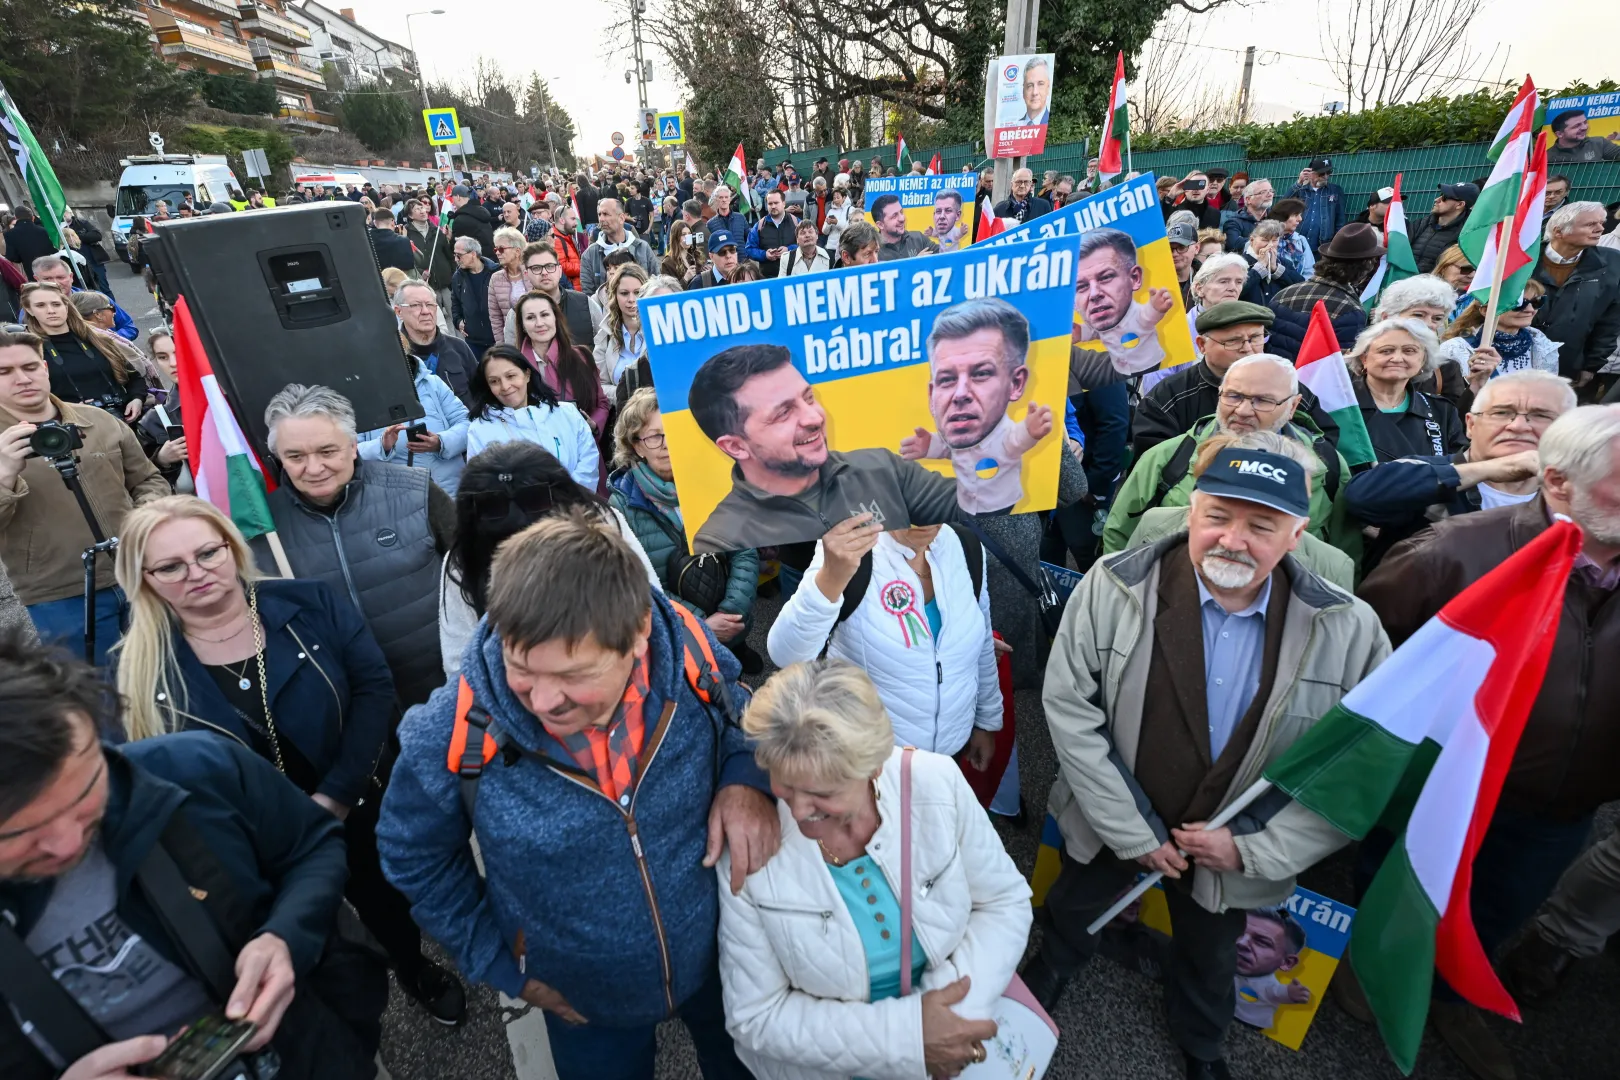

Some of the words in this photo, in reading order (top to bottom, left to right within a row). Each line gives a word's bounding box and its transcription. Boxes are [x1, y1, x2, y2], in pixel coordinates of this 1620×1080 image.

[1549, 97, 1585, 110] MONDJ
[1586, 94, 1620, 106] NEMET
[866, 179, 896, 192] MONDJ
[899, 177, 928, 190] NEMET
[931, 178, 941, 189] az
[945, 176, 974, 189] ukrán
[902, 192, 933, 206] bábra!
[1040, 216, 1066, 240] az
[1073, 183, 1155, 234] ukrán
[647, 288, 773, 346] MONDJ
[784, 269, 898, 326] NEMET
[912, 267, 952, 308] az
[964, 242, 1072, 299] ukrán
[803, 319, 921, 375] bábra!
[1239, 460, 1288, 482] MCC
